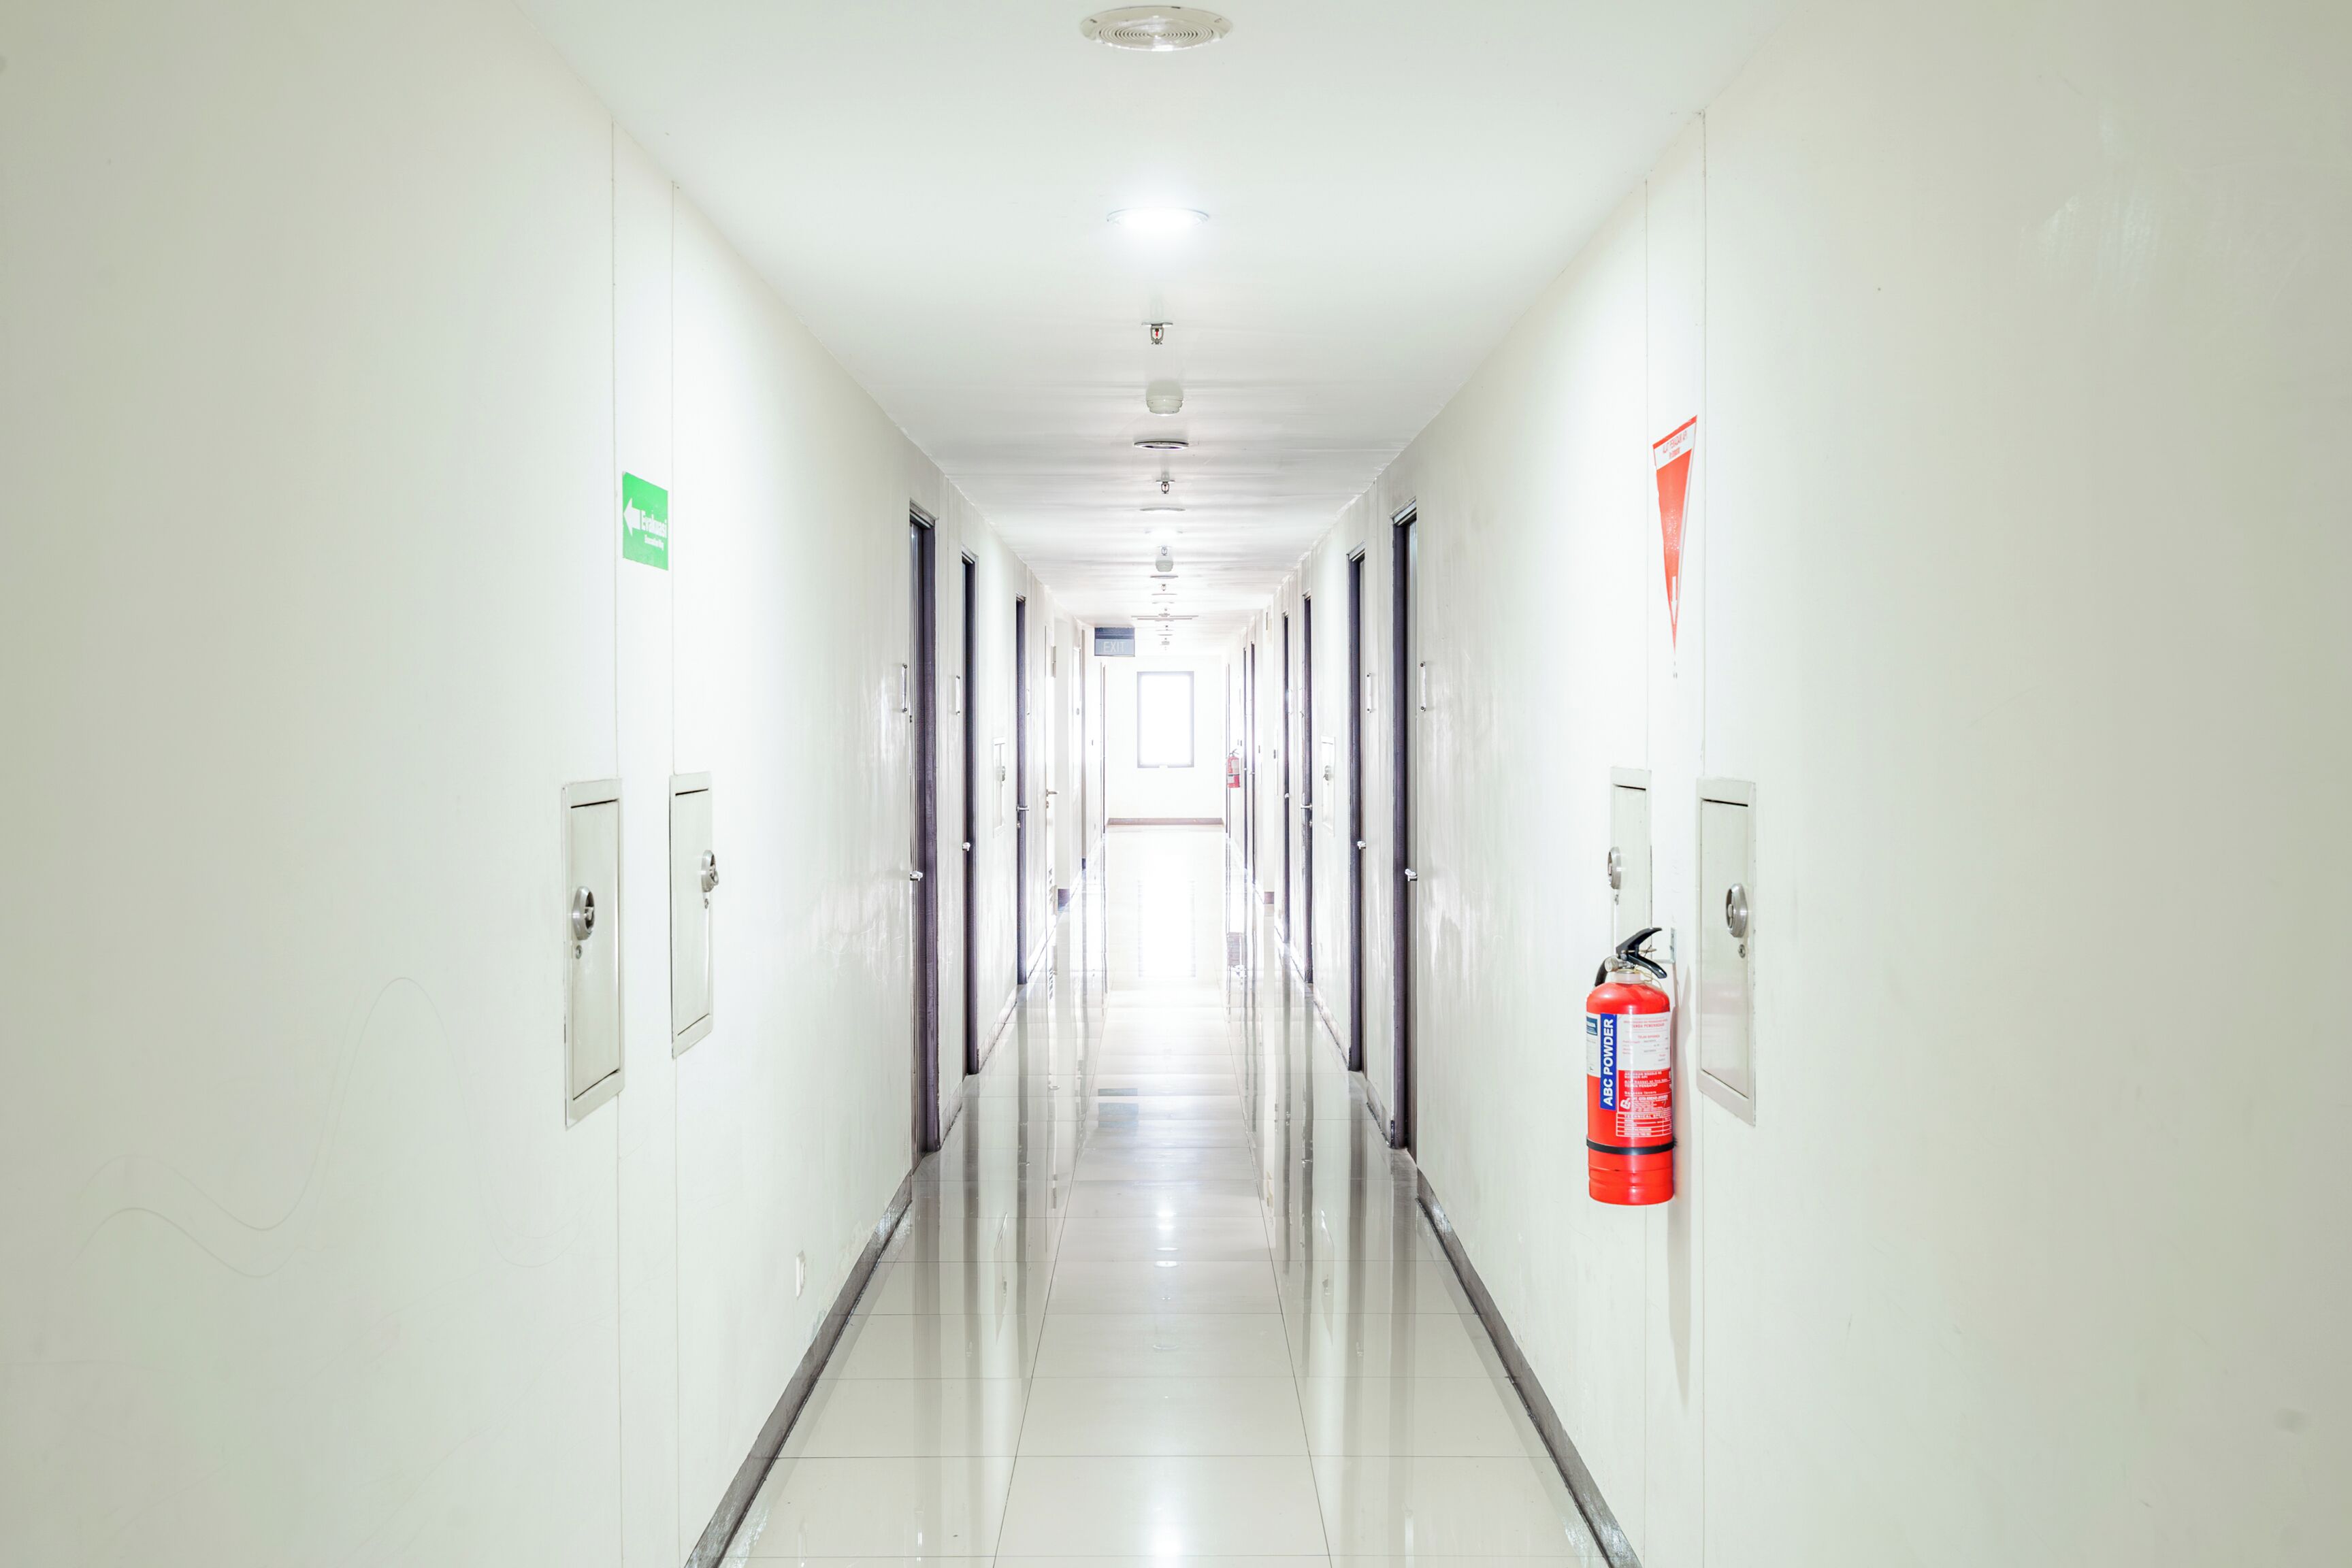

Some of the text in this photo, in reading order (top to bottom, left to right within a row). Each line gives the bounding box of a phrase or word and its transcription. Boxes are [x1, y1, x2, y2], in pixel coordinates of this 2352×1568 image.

[1103, 641, 1125, 654] EXIT
[1603, 1018, 1614, 1107] ABC POWDER
